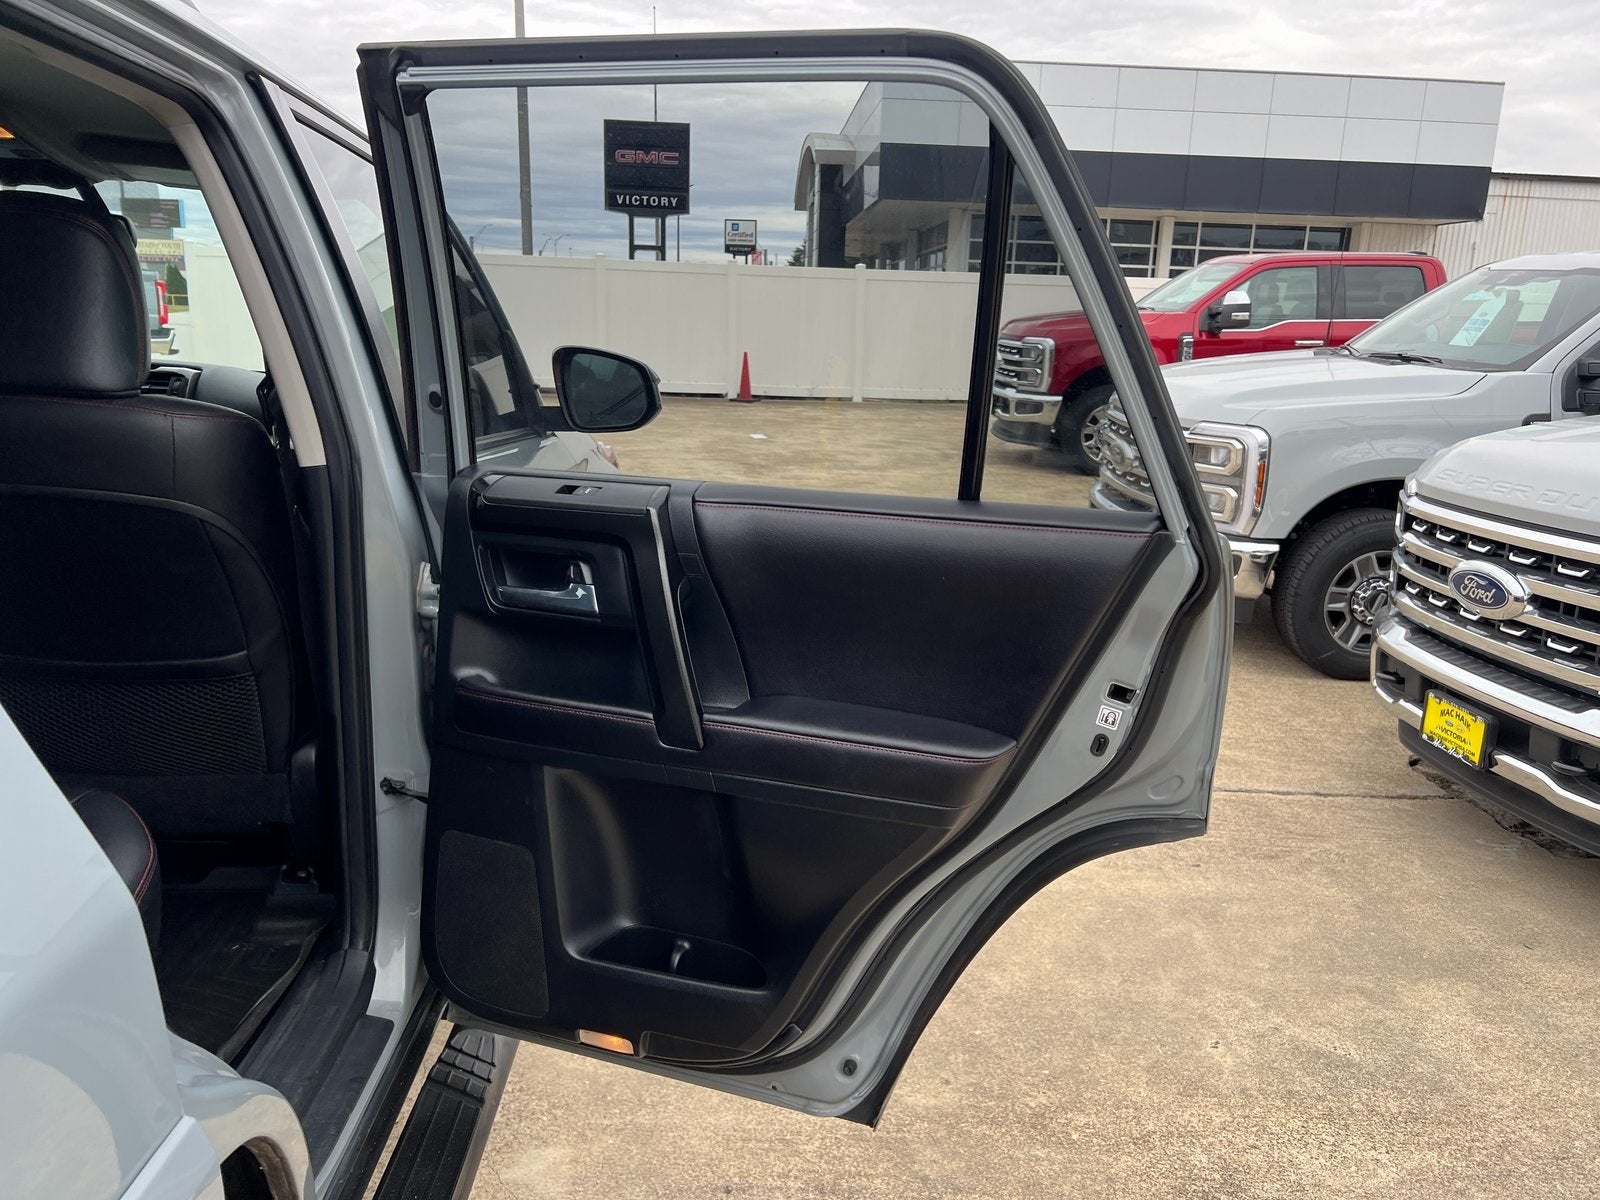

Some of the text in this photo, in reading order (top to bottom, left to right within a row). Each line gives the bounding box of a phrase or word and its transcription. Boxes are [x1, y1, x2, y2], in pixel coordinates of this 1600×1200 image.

[615, 149, 680, 165] GMC
[616, 194, 678, 207] VICTORY
[1435, 468, 1600, 513] SUPER DU
[1460, 575, 1497, 604] Ford
[1440, 708, 1471, 732] MAC HAIK
[1442, 727, 1467, 745] VICTORIA
